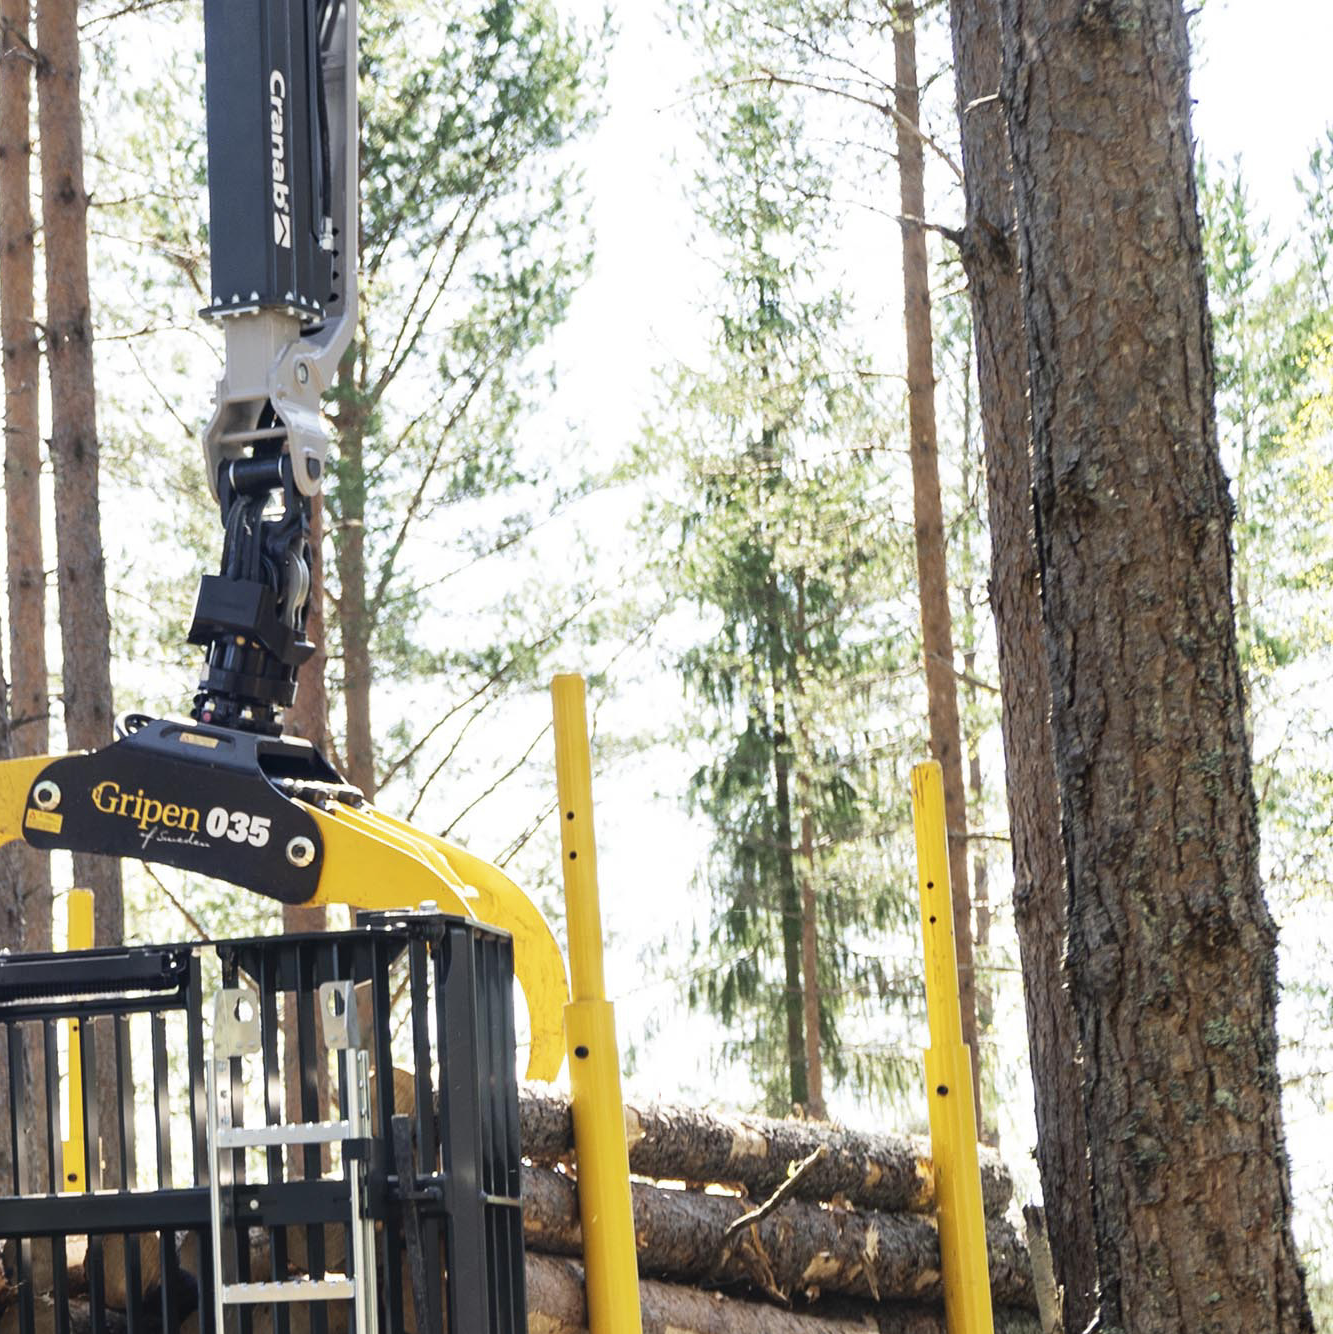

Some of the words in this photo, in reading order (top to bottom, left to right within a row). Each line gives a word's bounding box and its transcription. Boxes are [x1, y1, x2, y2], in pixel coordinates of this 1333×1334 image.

[269, 69, 290, 210] Cranab
[91, 780, 201, 834] Gripen
[205, 806, 272, 848] 035
[139, 825, 159, 850] of
[157, 829, 212, 848] Sweden
